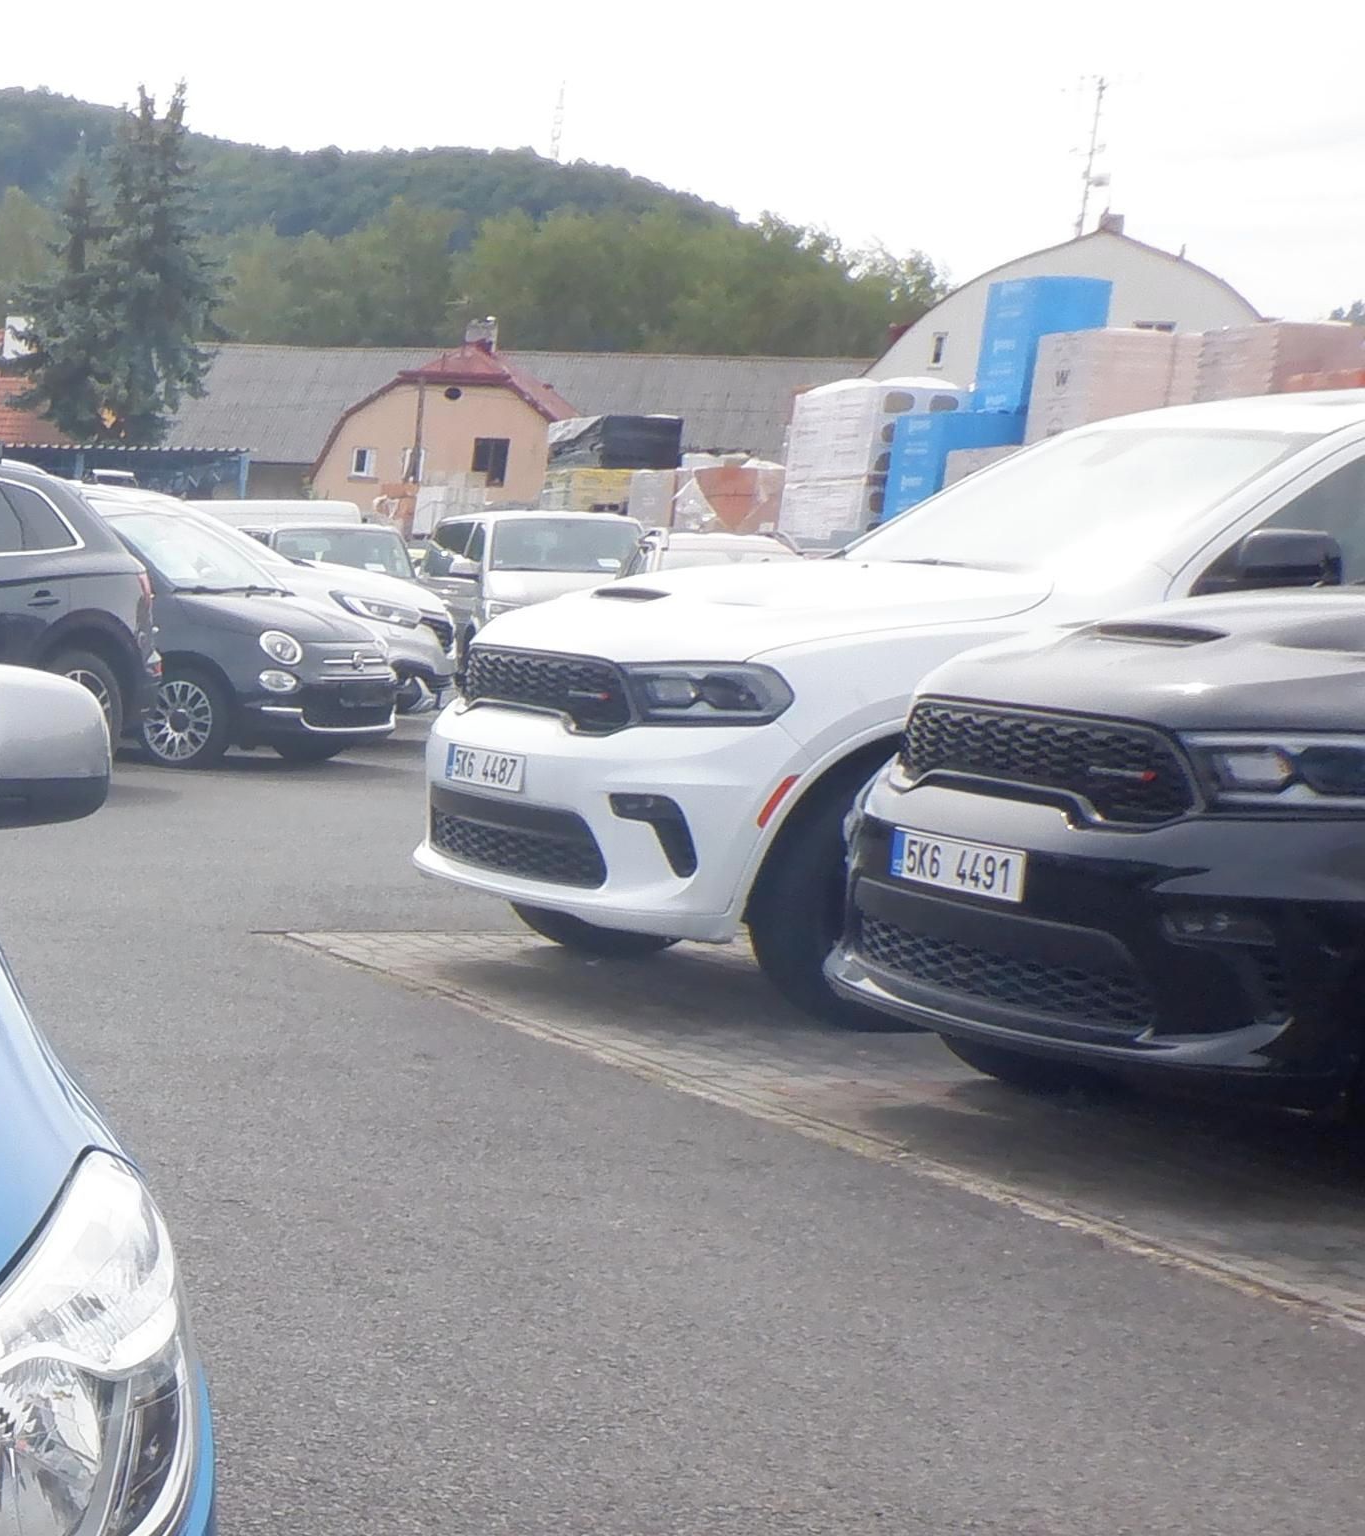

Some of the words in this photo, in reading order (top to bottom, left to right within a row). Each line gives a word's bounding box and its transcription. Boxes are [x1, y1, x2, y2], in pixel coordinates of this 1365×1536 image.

[454, 749, 477, 778] 5K6
[481, 754, 518, 786] 4487
[906, 840, 942, 878] 5K6
[955, 849, 1012, 893] 4491
